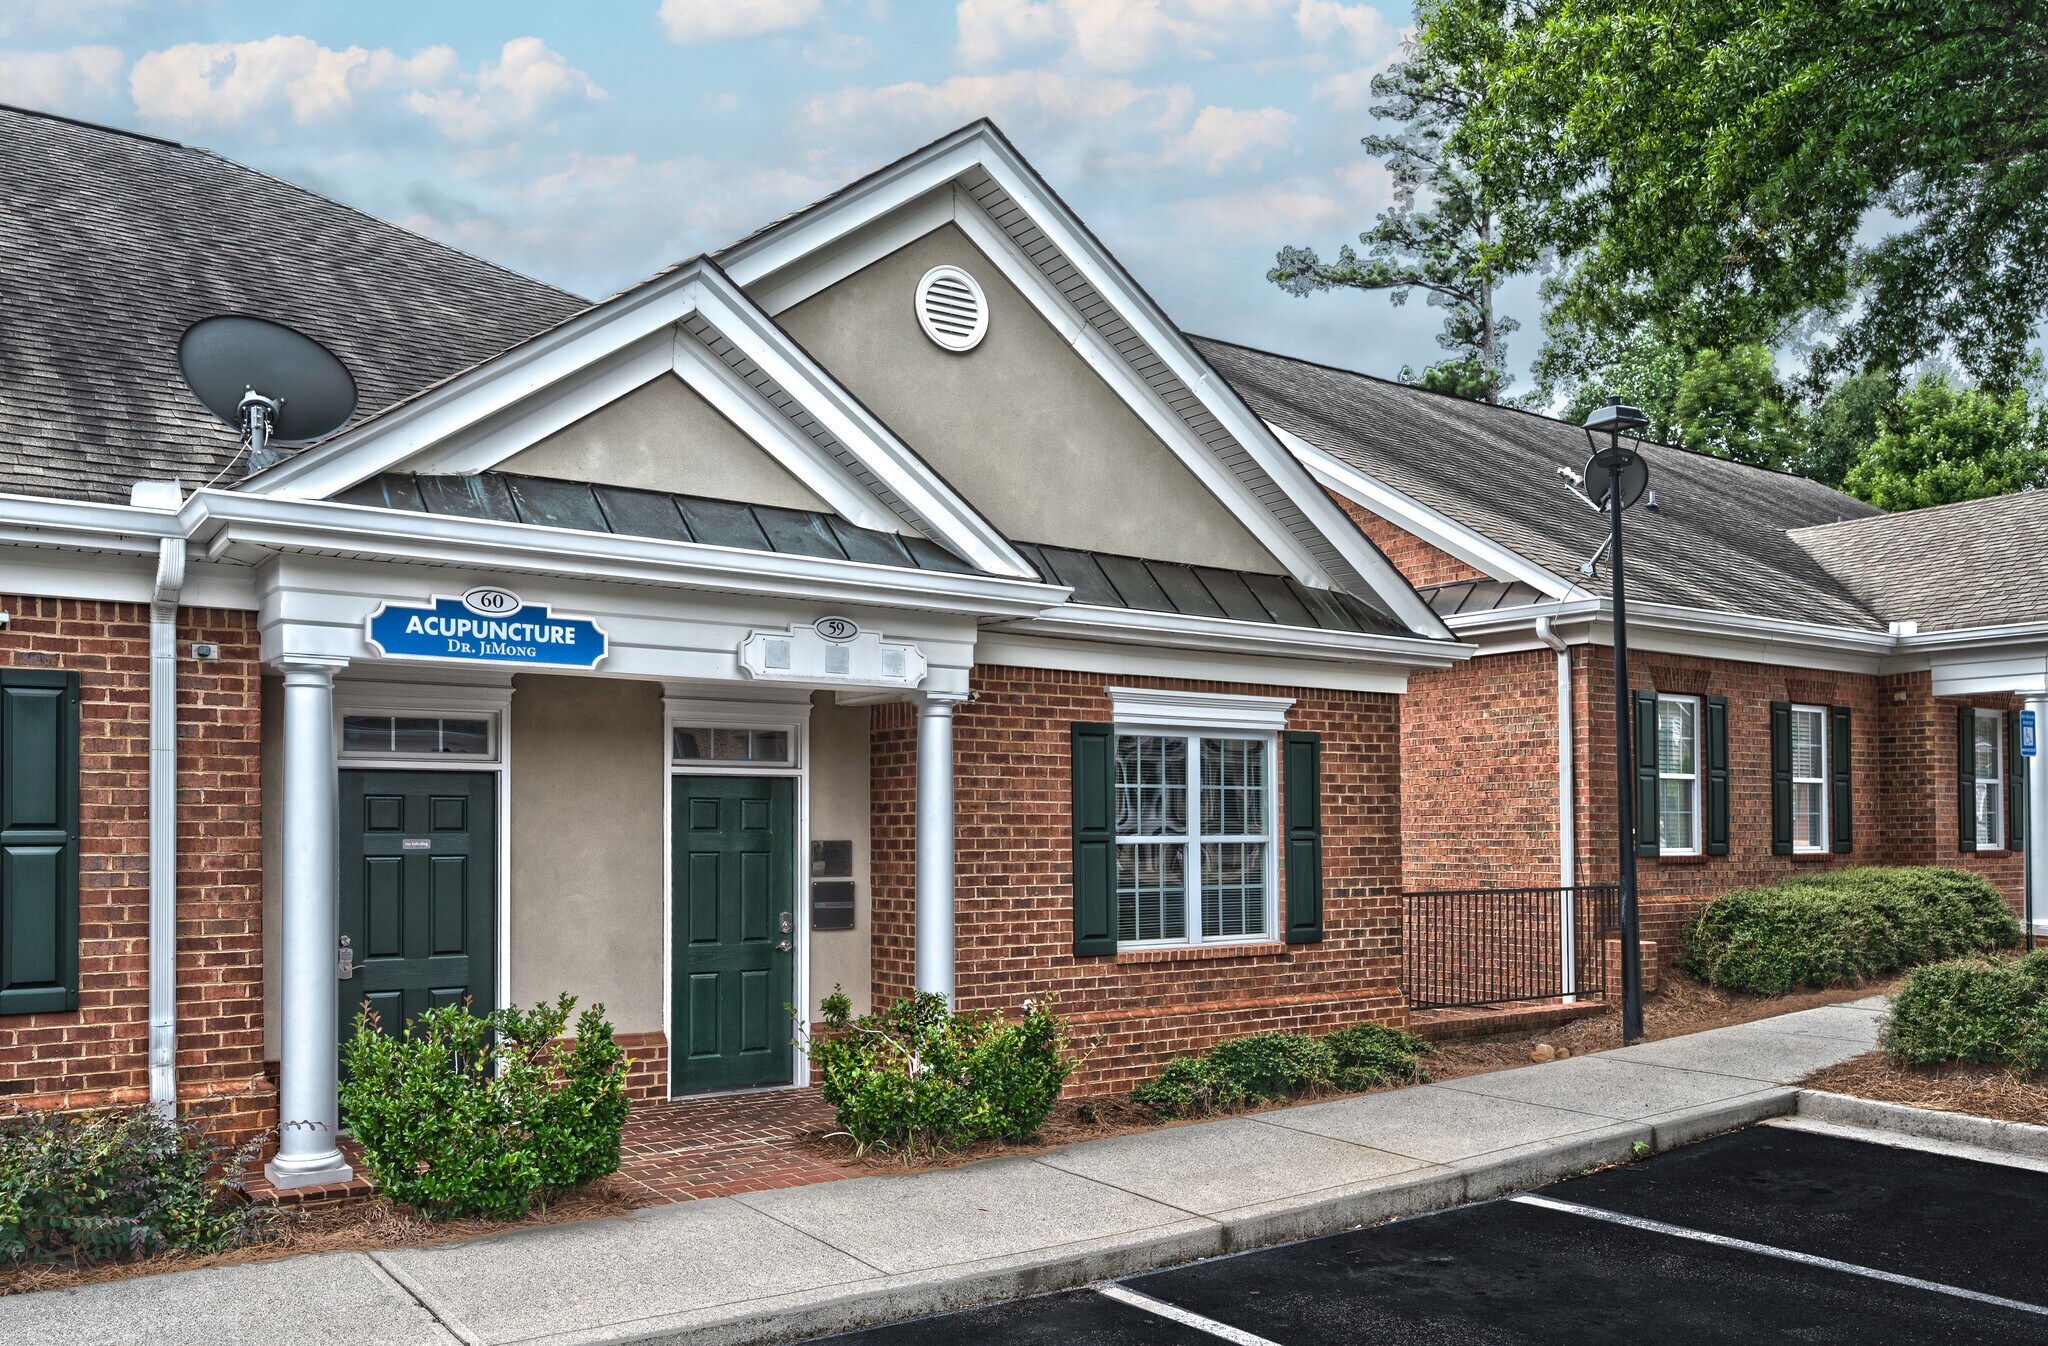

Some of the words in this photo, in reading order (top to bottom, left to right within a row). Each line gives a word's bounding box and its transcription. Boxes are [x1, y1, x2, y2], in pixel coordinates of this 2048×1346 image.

[480, 592, 504, 608] 60
[405, 616, 576, 645] ACUPUNCTURE
[829, 621, 845, 636] 59
